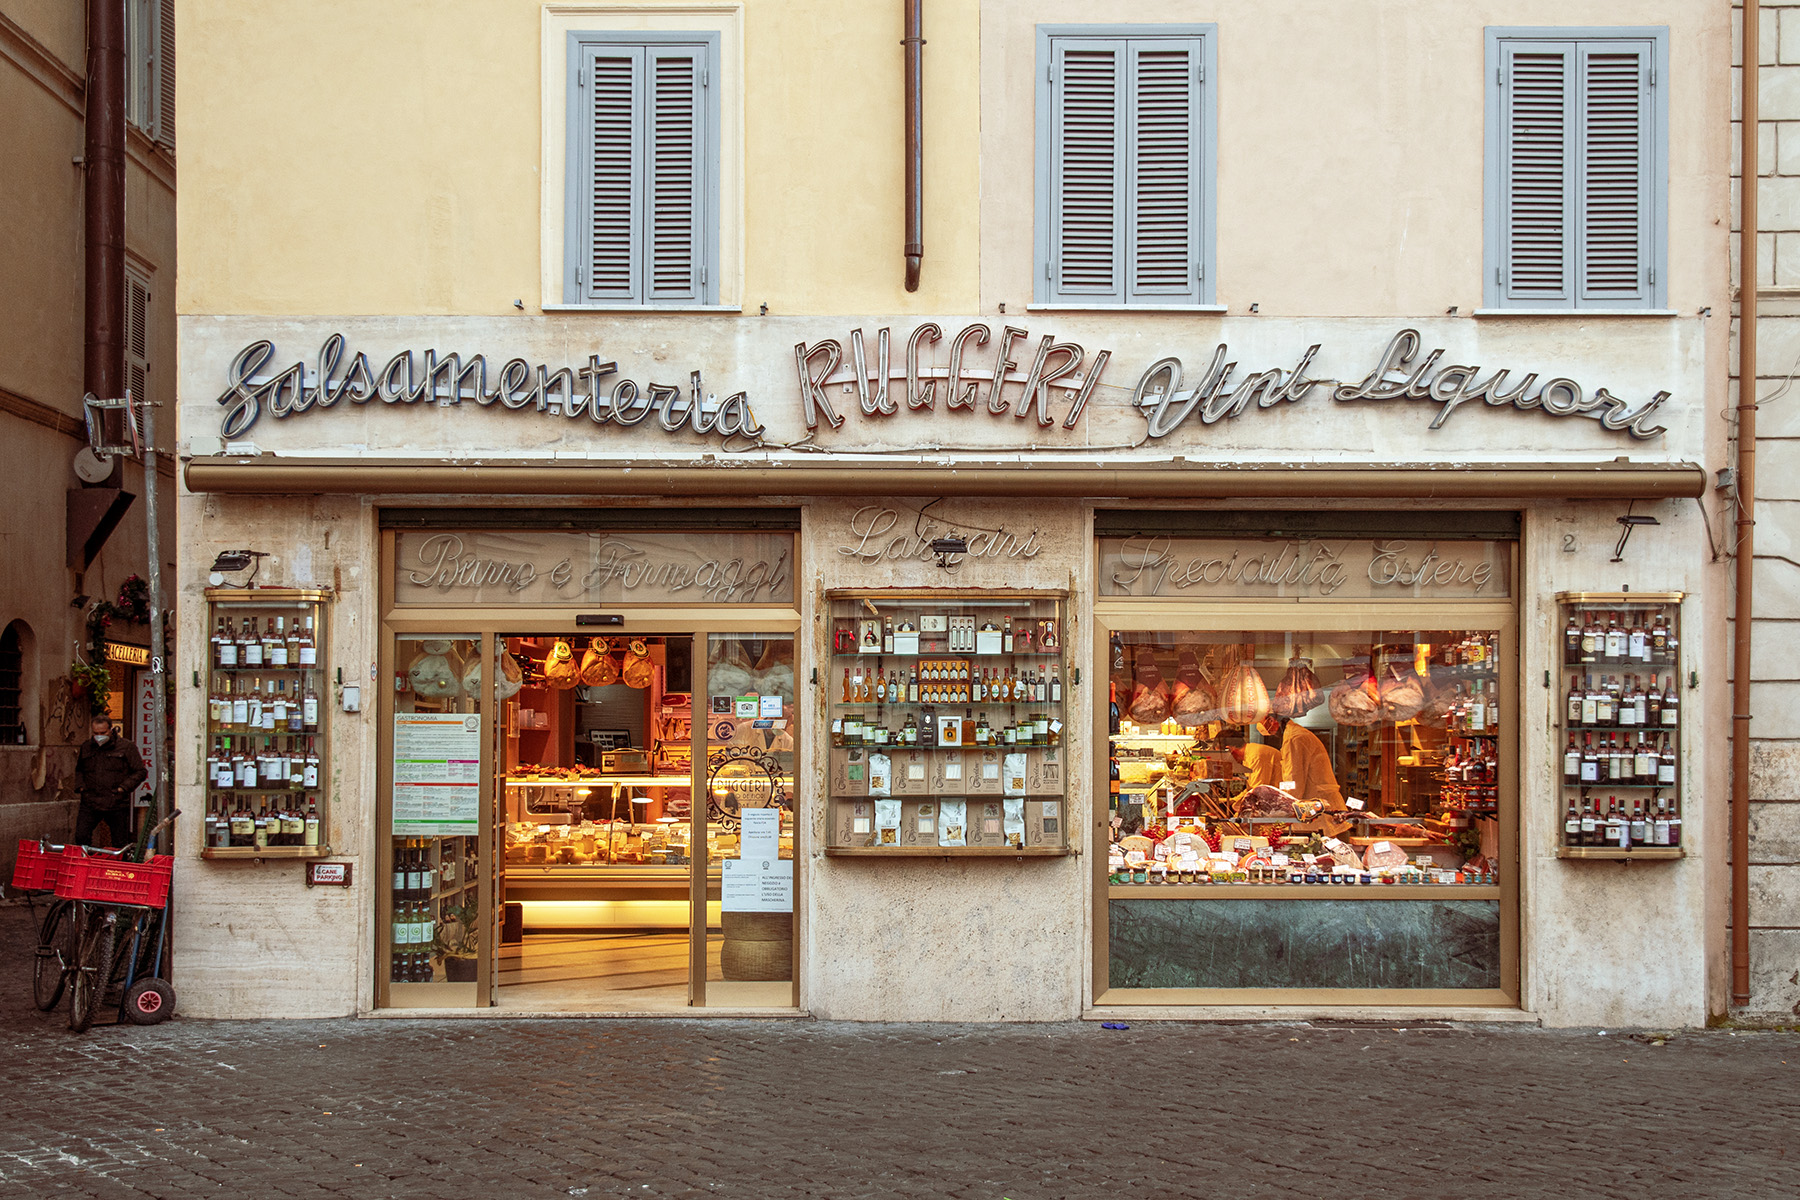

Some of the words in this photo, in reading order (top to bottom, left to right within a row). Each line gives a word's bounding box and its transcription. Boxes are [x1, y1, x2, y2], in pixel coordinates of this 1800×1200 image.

[217, 333, 767, 439] Salsamenteria
[794, 322, 1113, 431] RUGGERI
[1132, 342, 1322, 439] Vini
[1334, 328, 1673, 441] Liquori
[409, 533, 538, 593] Burro
[1563, 534, 1576, 553] 2
